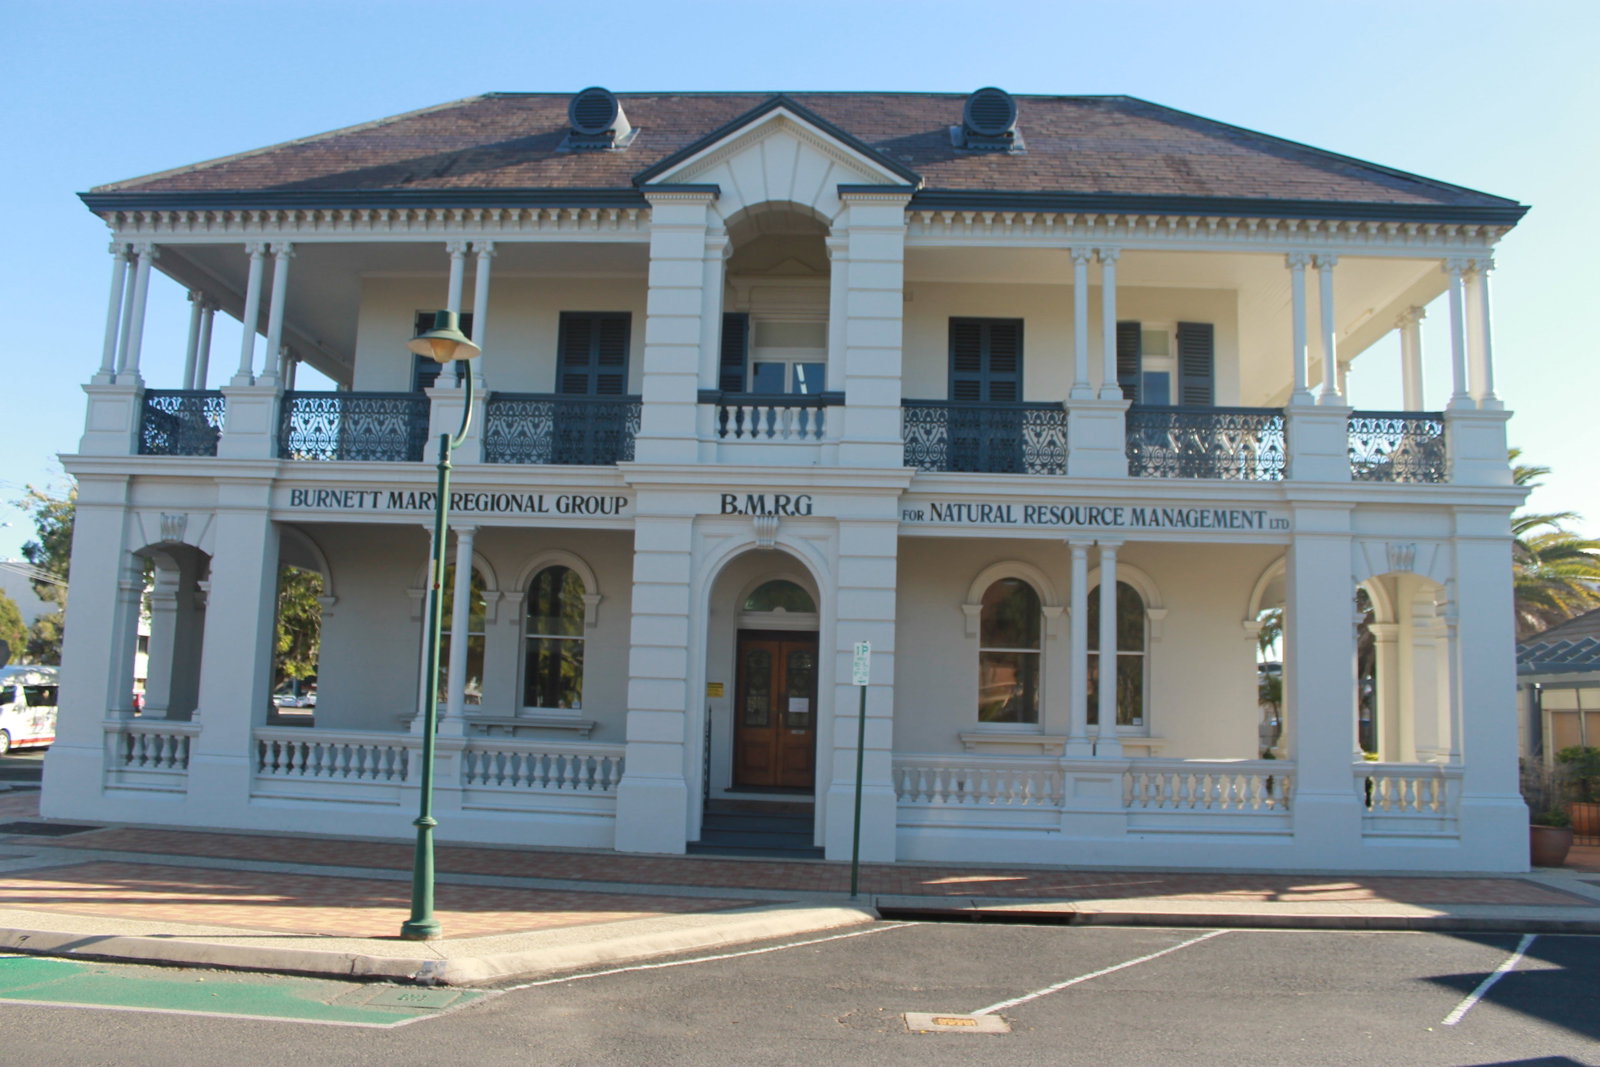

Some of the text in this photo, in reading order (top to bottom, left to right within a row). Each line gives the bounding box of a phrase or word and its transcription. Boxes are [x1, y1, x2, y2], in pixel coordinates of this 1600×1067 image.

[290, 488, 383, 509] BURNETT
[449, 492, 549, 513] REGIONAL
[555, 495, 628, 515] GROUP
[720, 493, 813, 517] B.M.R.G
[902, 502, 1290, 530] FOR NATURAL RESOURCE MANAGEMENT LTD
